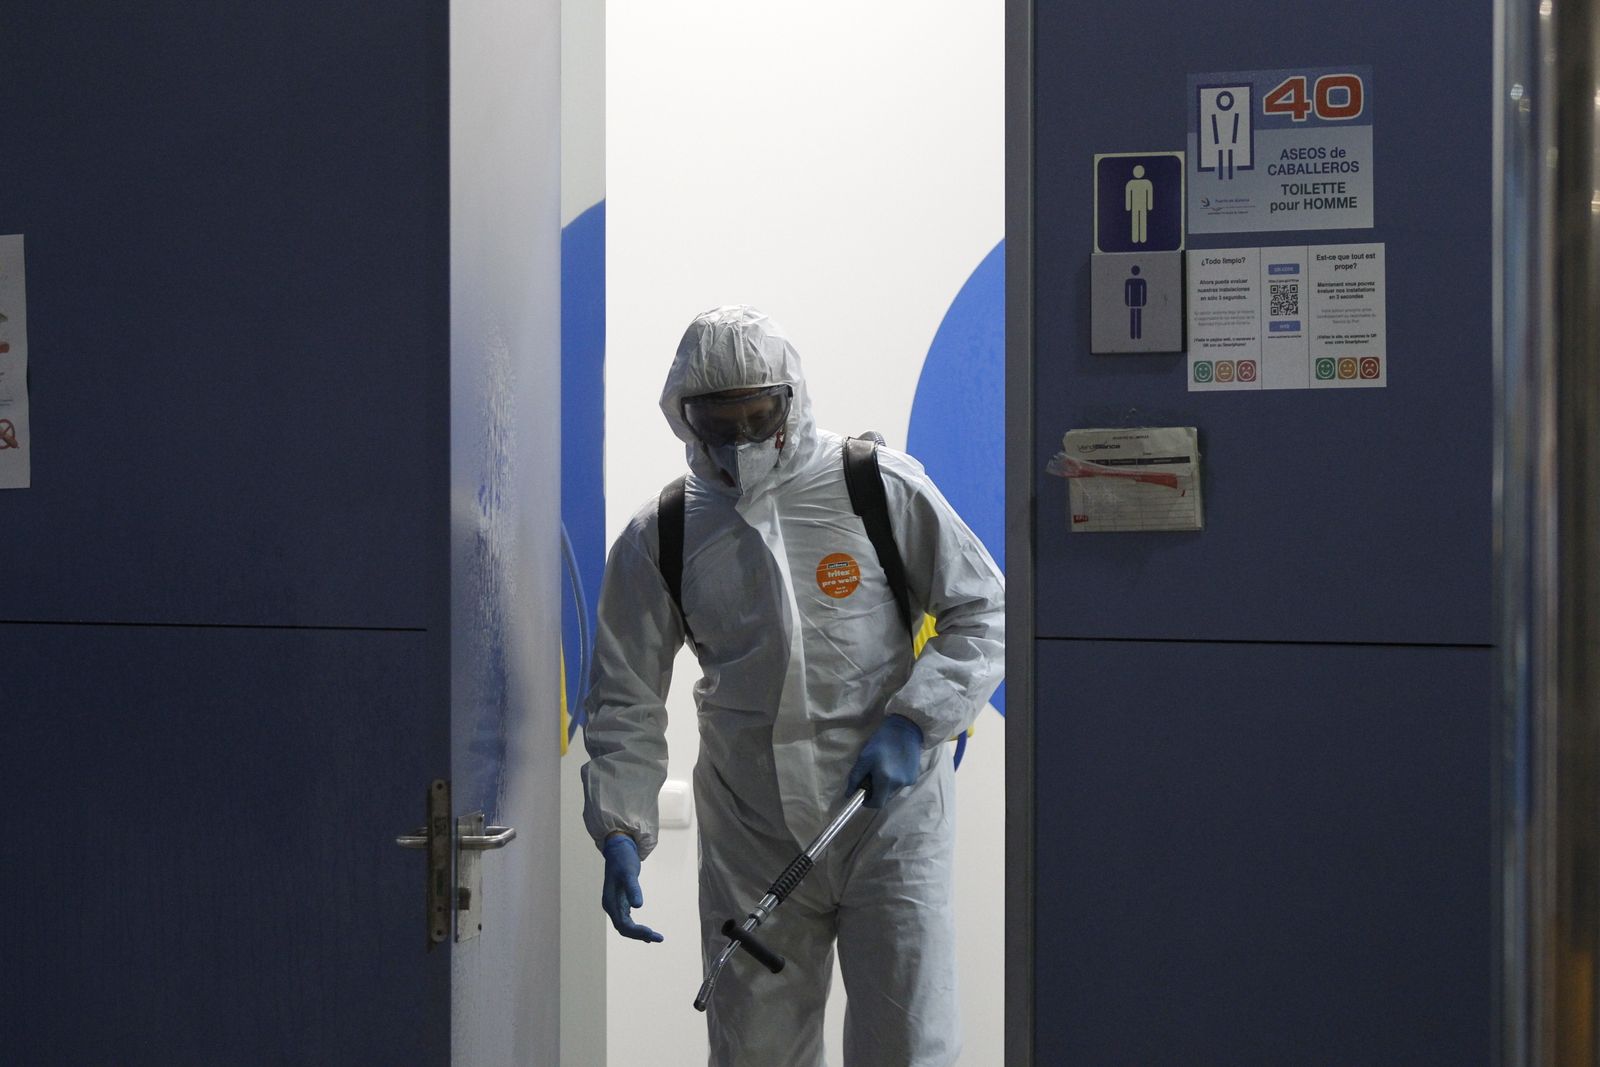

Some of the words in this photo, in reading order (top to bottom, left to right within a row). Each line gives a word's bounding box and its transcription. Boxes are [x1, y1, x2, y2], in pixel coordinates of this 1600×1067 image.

[1263, 73, 1363, 122] 40
[1280, 147, 1326, 160] ASEOS
[1330, 146, 1346, 159] de
[1267, 161, 1359, 176] CABALLEROS
[1281, 182, 1346, 195] TOILETTE
[1270, 199, 1300, 213] pour
[1303, 196, 1358, 210] HOMME
[1201, 258, 1221, 266] ¿Todo
[1222, 256, 1246, 265] limpio?
[1334, 262, 1357, 271] prope?
[822, 580, 836, 588] pro
